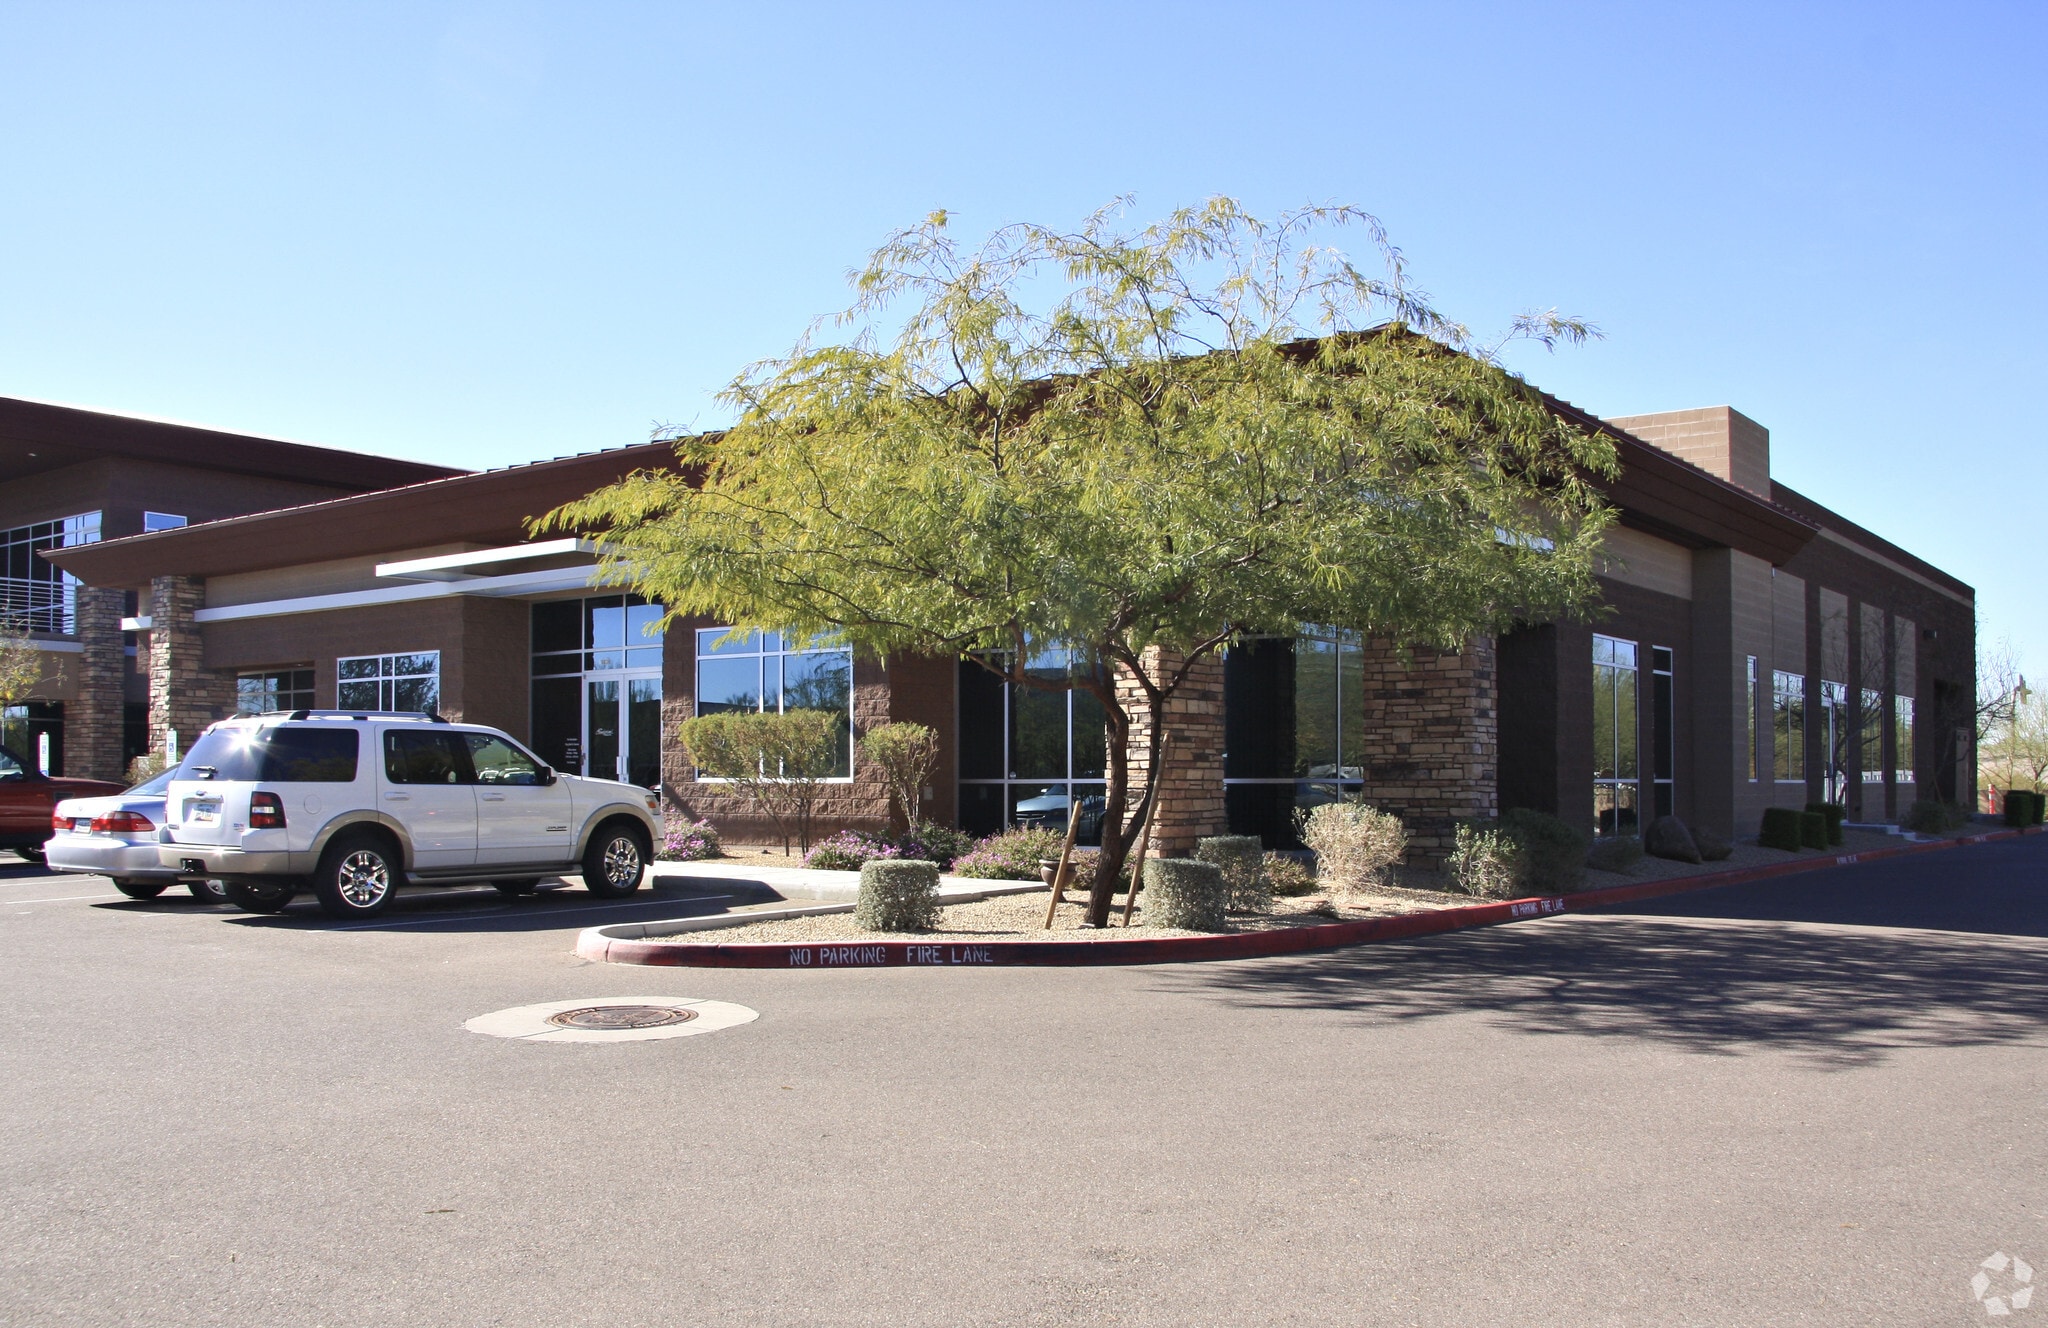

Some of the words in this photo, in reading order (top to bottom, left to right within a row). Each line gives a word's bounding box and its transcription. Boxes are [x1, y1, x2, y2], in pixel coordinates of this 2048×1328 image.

[789, 949, 811, 966] NO
[819, 946, 886, 965] PARKING
[906, 945, 943, 963] FIRE
[951, 946, 994, 963] LANE
